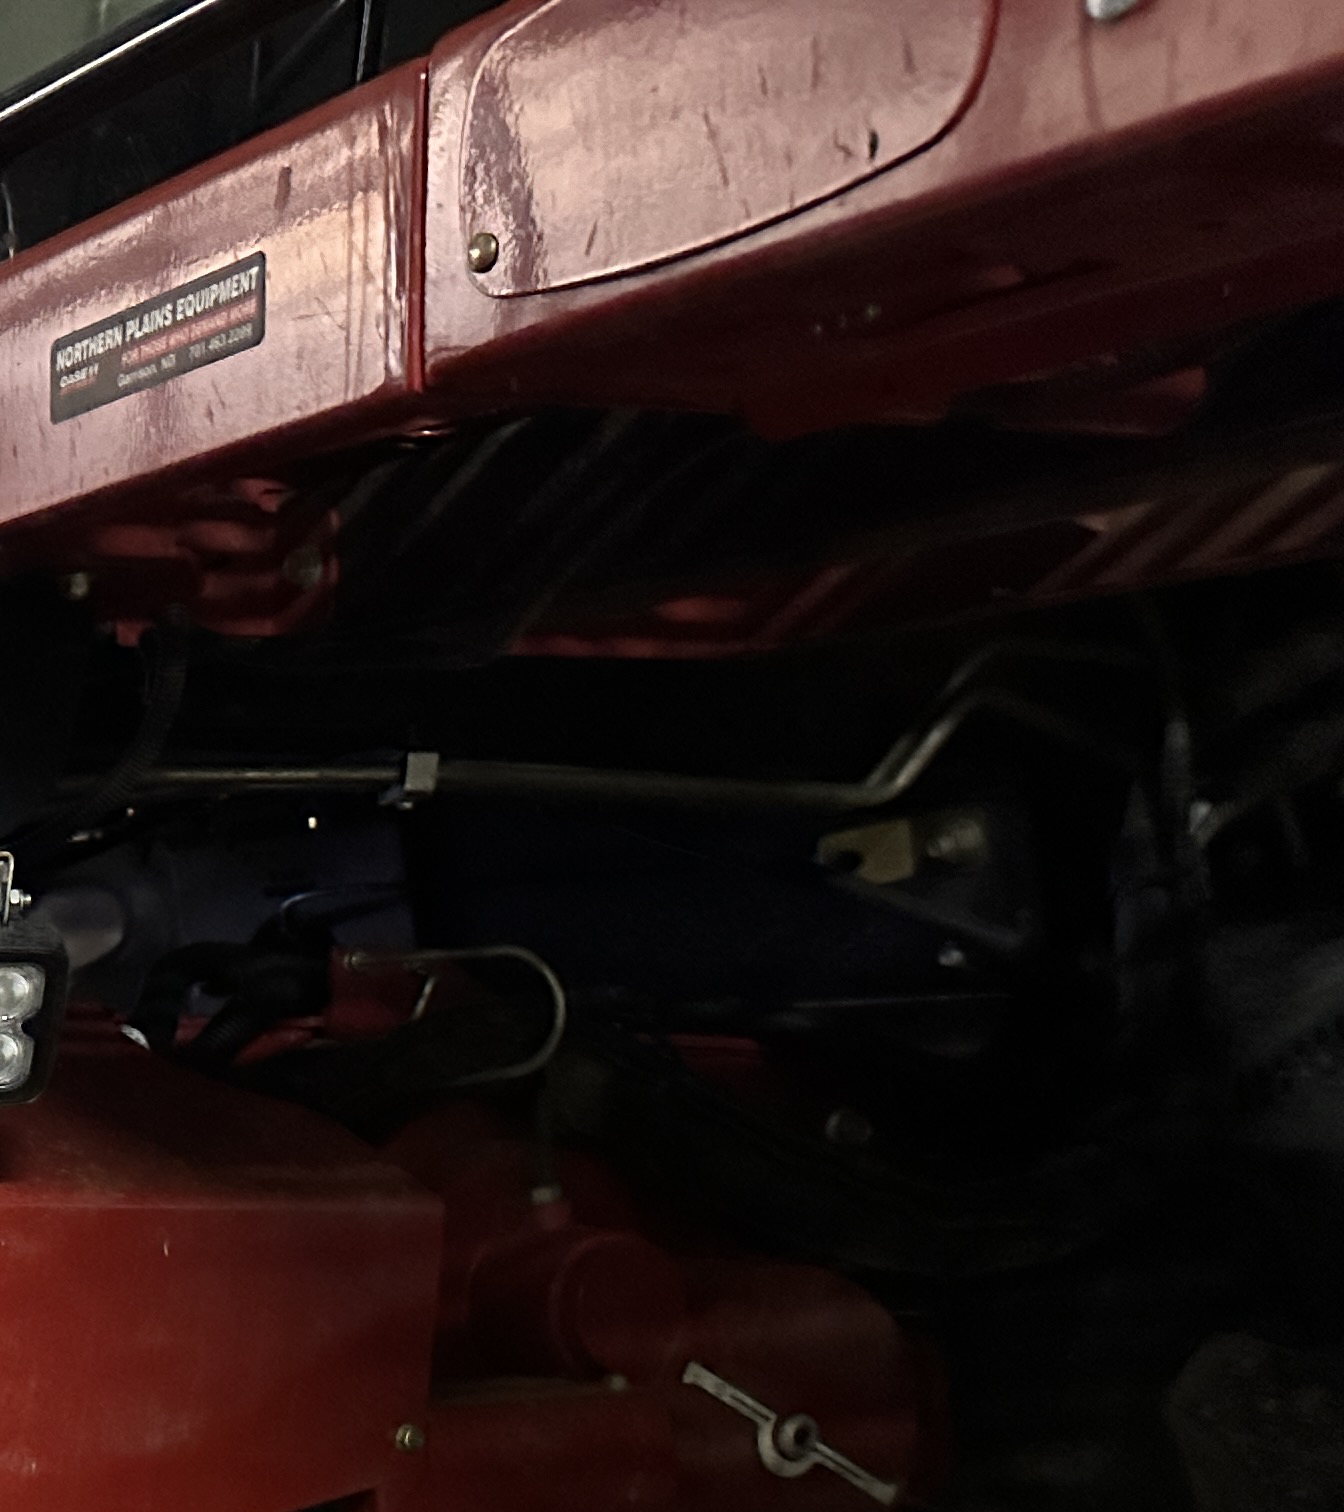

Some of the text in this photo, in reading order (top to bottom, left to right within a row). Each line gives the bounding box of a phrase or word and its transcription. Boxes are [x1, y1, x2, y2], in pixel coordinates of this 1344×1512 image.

[56, 324, 124, 372] NORTHERN
[125, 303, 173, 342] PLAINS
[176, 266, 260, 320] EQUIPMENT
